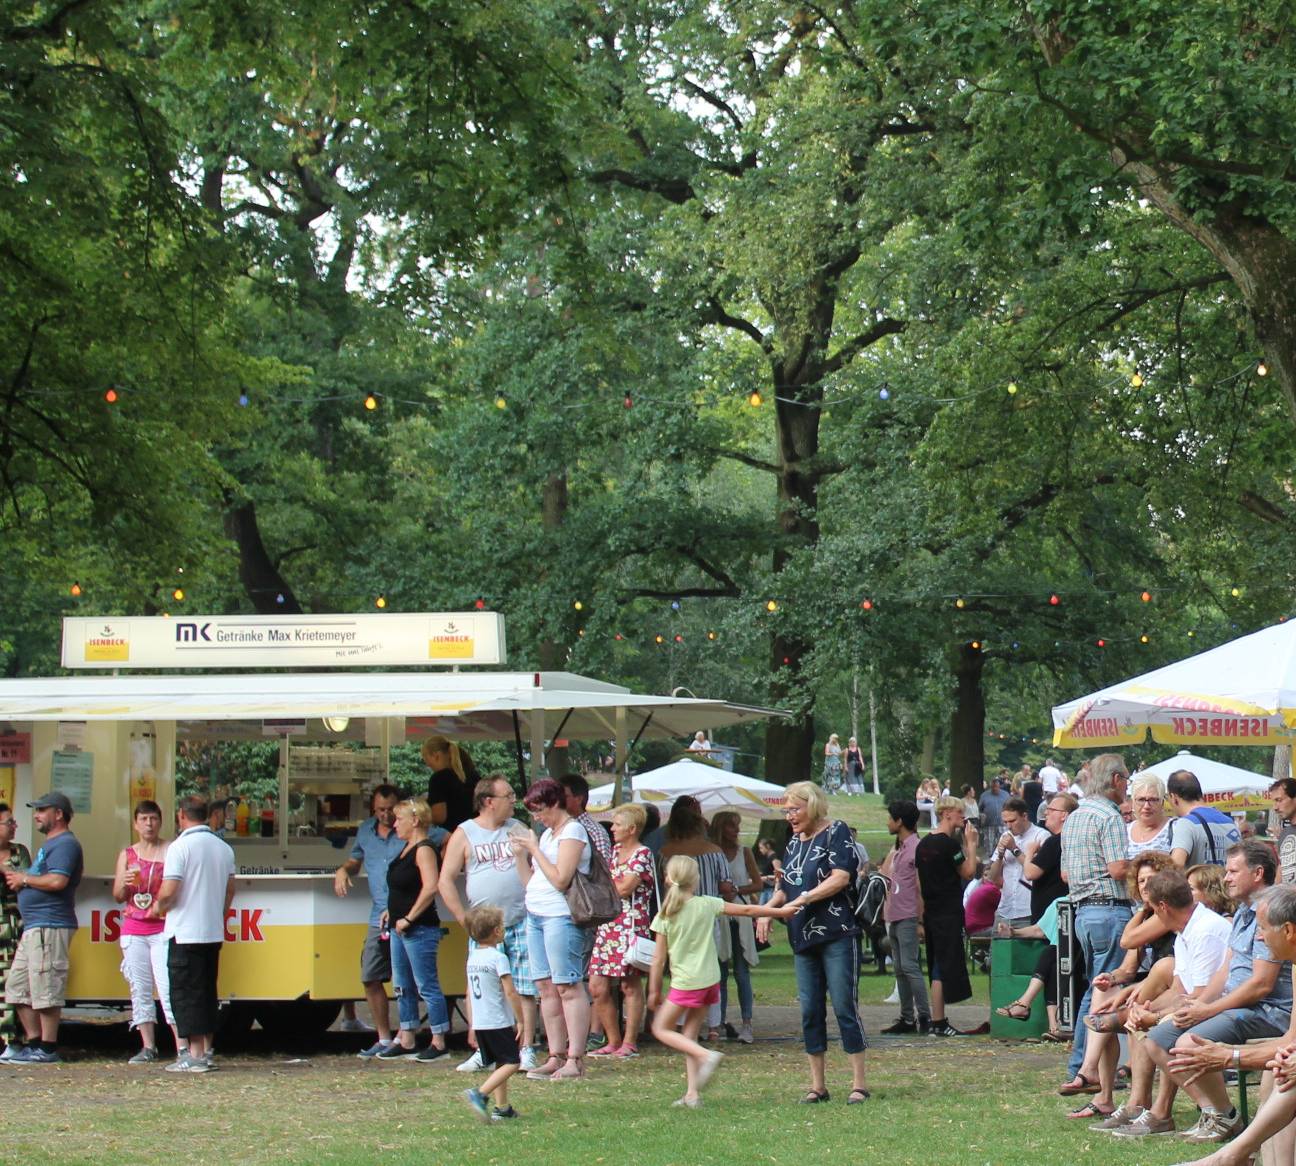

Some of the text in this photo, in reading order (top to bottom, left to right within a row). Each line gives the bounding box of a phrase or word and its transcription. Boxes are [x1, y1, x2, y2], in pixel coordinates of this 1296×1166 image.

[217, 629, 264, 642] Getränke
[268, 629, 291, 641] Max
[295, 628, 356, 643] Krietemeyer
[89, 638, 125, 646] ISENBECK
[240, 865, 280, 875] Getränke
[470, 975, 482, 1000] 13
